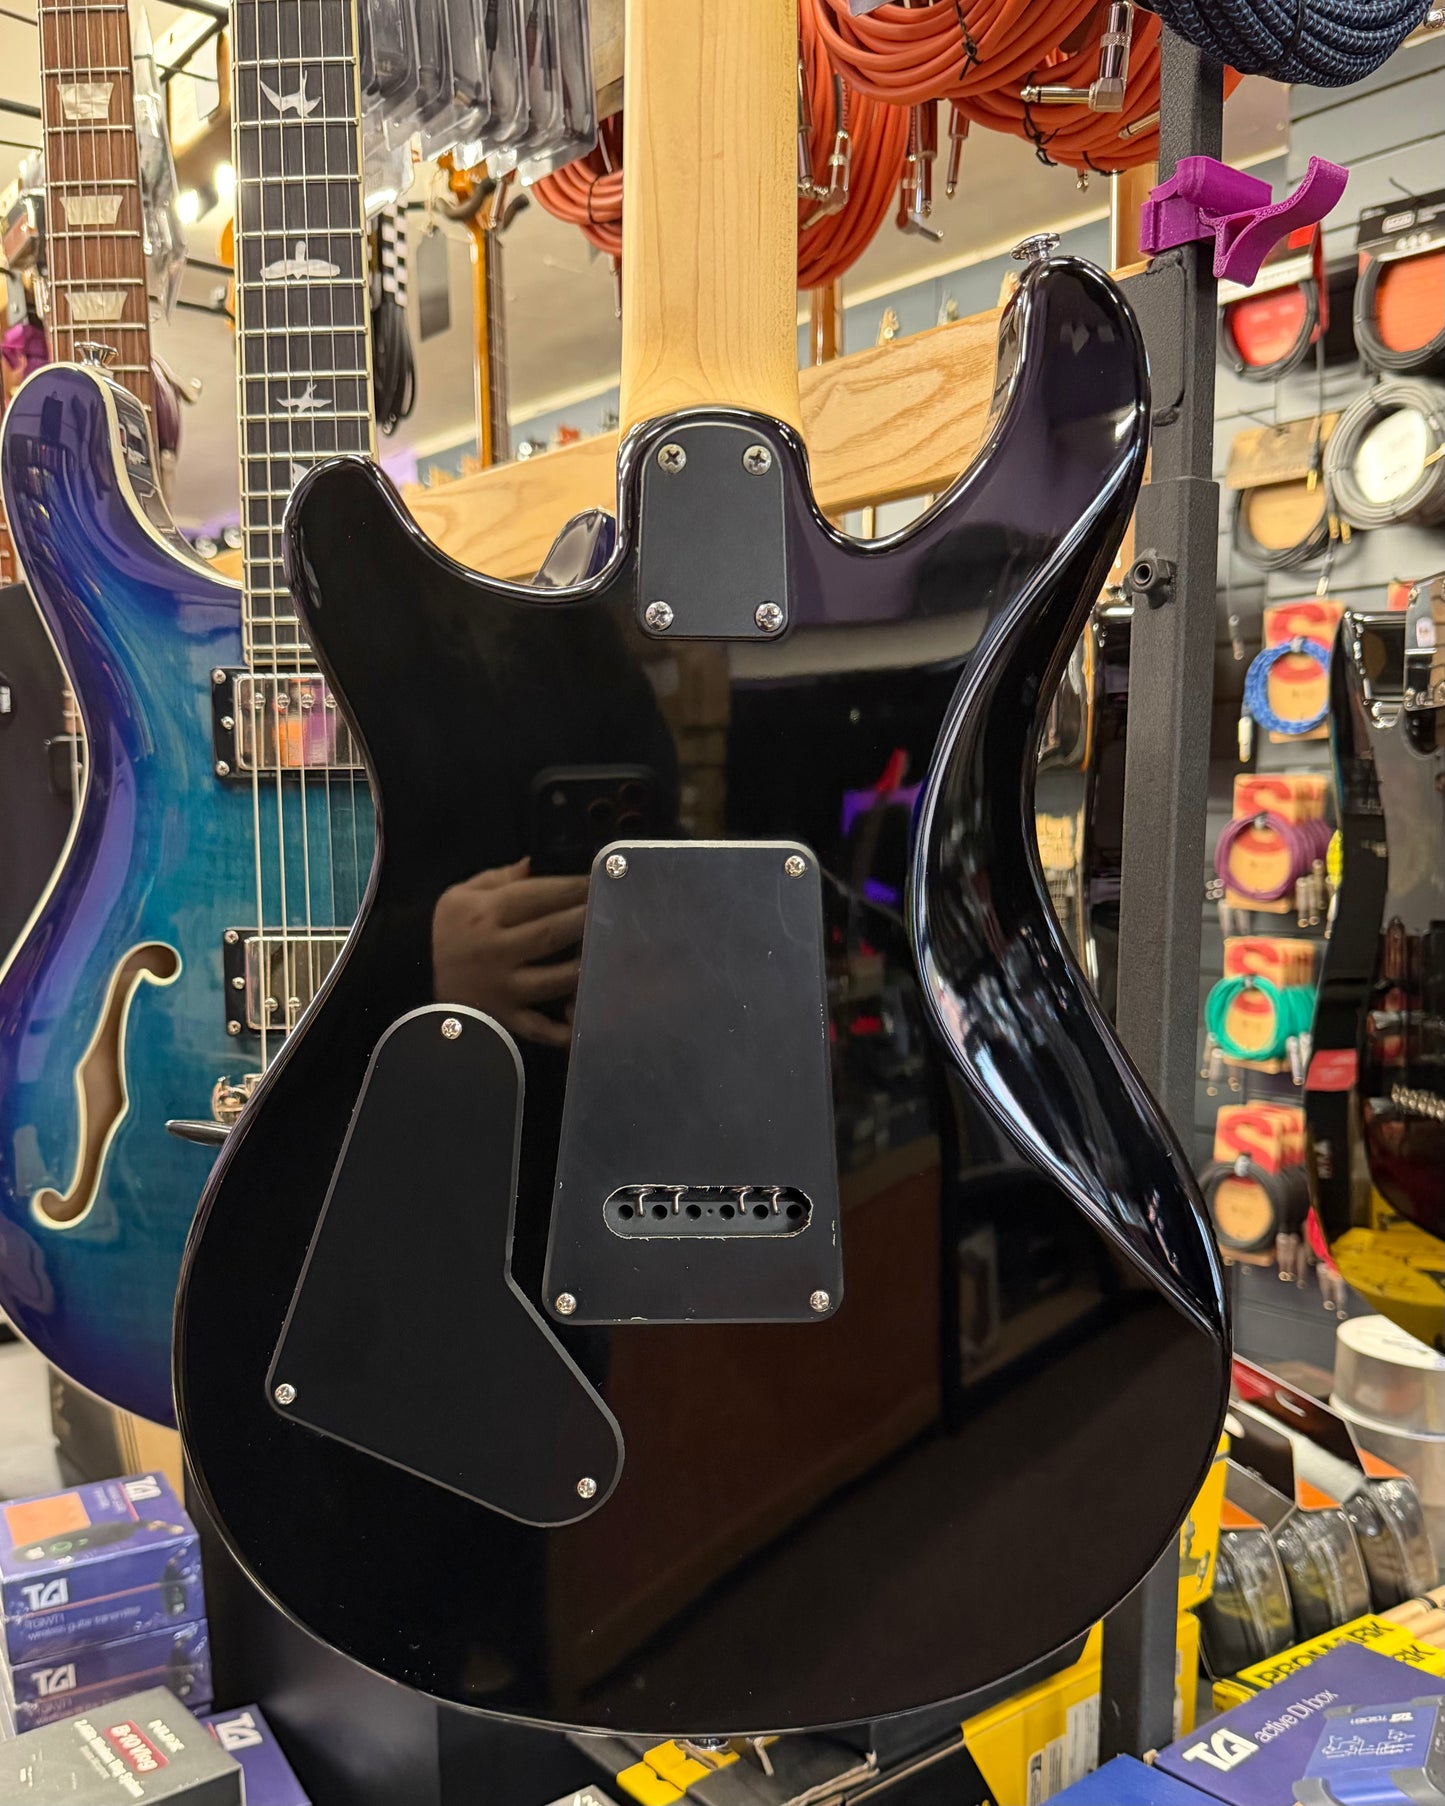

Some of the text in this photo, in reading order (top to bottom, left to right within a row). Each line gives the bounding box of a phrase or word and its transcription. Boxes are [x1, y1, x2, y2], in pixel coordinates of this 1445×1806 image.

[147, 1719, 185, 1753] NUX
[1254, 1713, 1299, 1744] active
[1301, 1689, 1339, 1710] box
